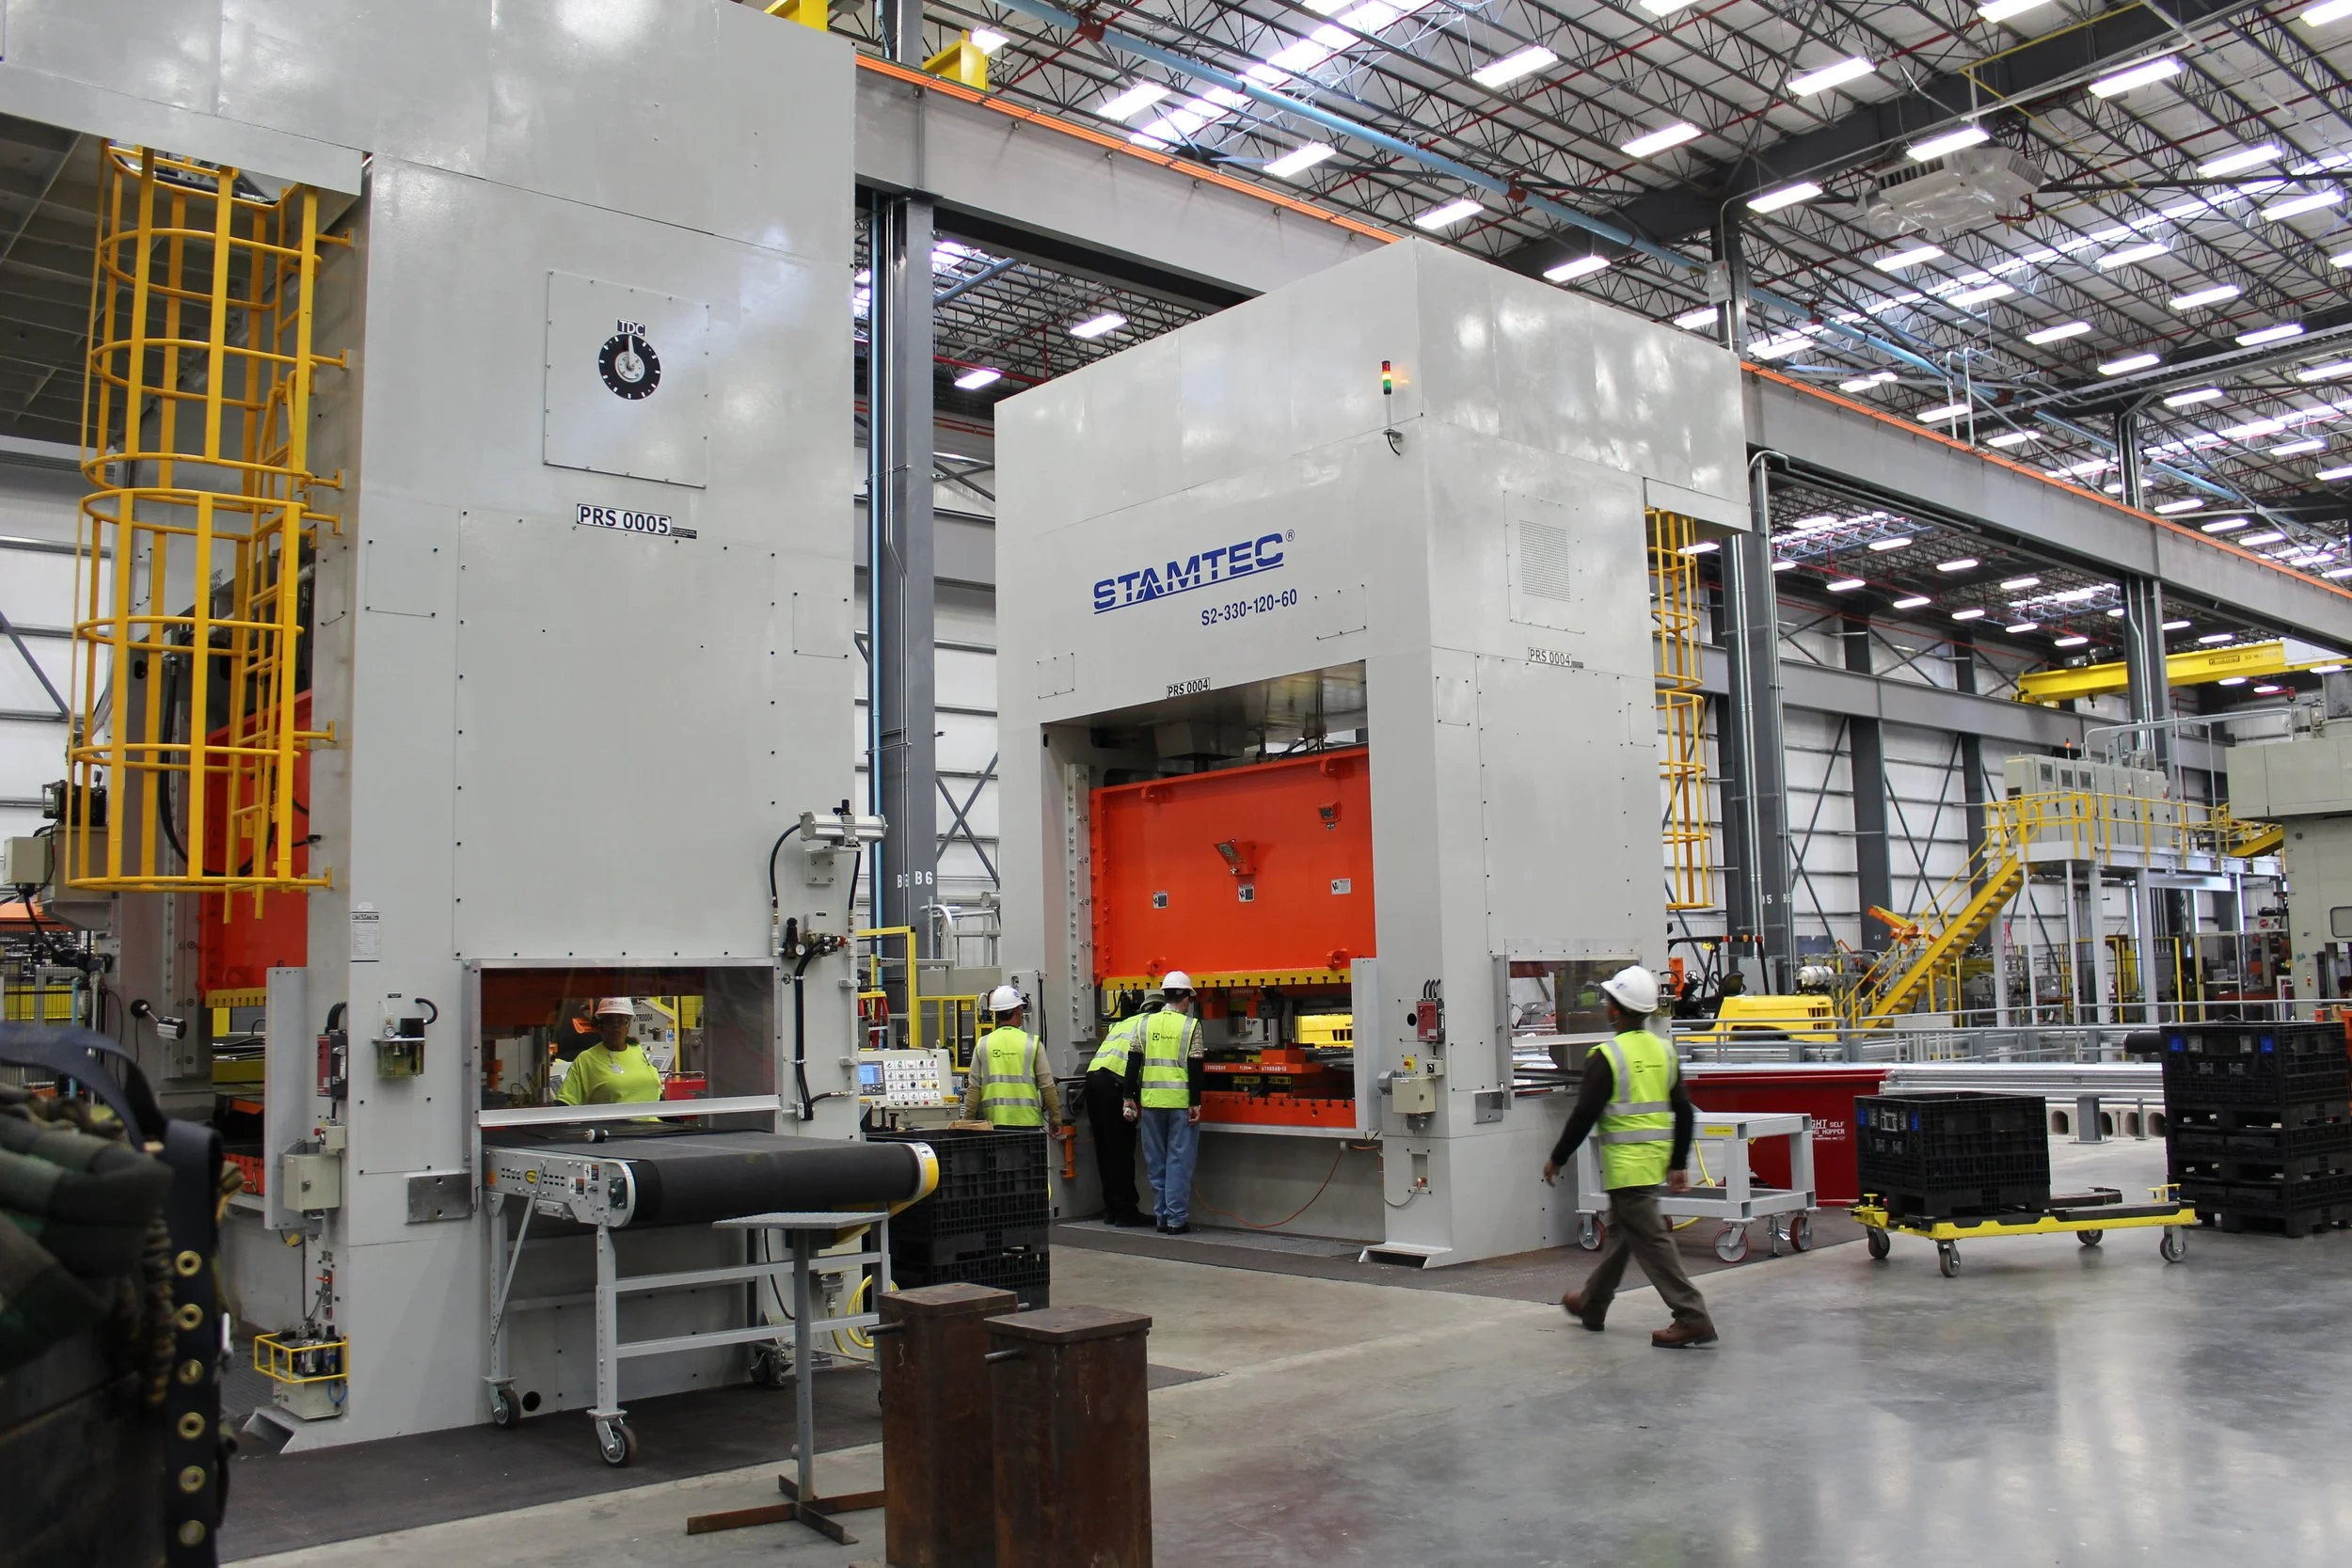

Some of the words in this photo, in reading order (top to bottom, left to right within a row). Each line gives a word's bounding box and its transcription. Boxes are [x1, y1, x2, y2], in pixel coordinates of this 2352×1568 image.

[619, 320, 645, 336] TDC
[580, 506, 616, 527] PRS
[622, 512, 668, 533] 0005
[1201, 589, 1297, 626] S2-330-120-60
[1530, 649, 1547, 662] PRS
[1549, 652, 1570, 665] 0004
[1168, 683, 1184, 697] PRS
[1186, 678, 1208, 693] 0004
